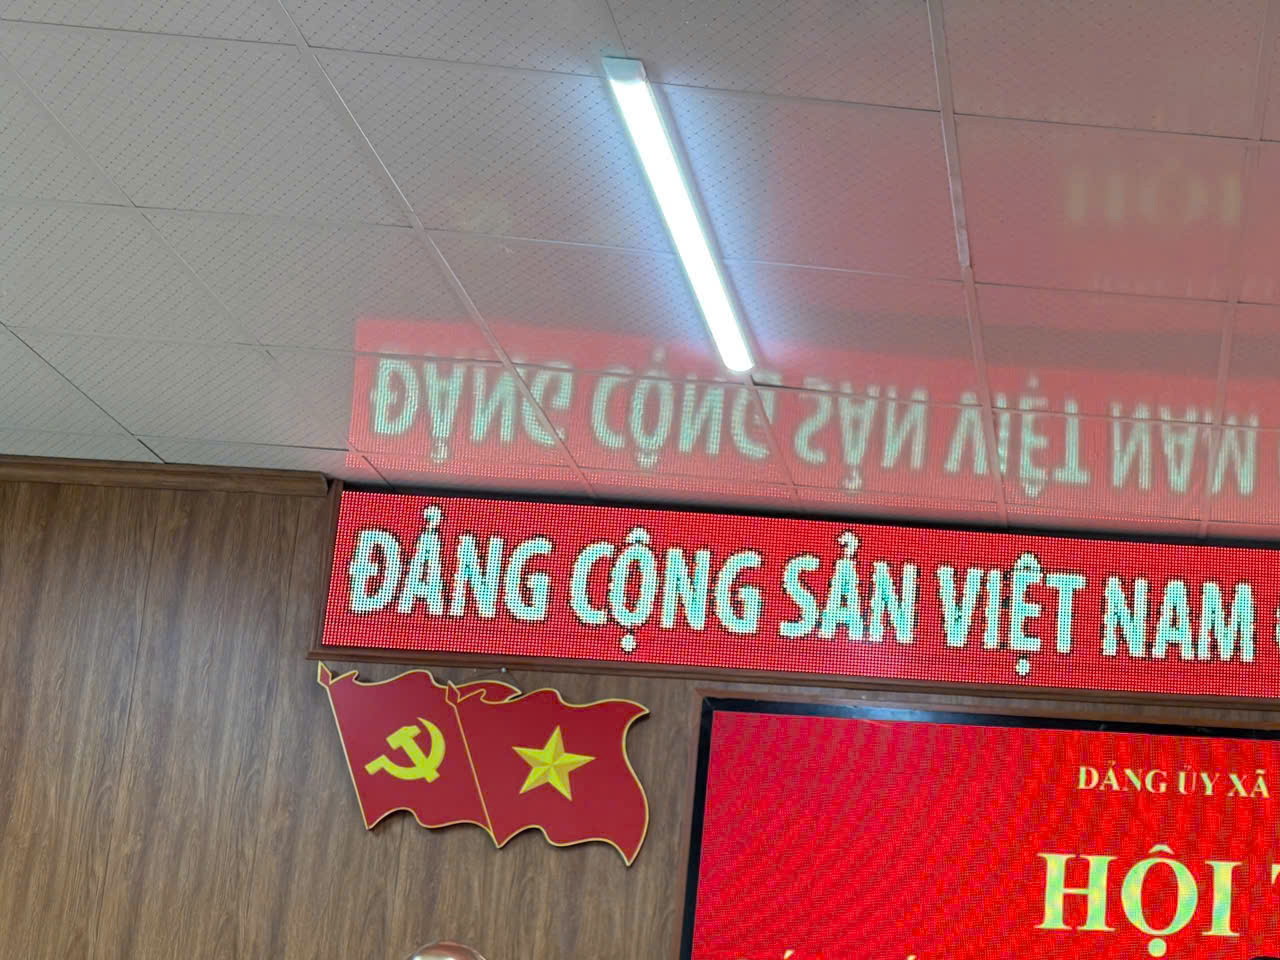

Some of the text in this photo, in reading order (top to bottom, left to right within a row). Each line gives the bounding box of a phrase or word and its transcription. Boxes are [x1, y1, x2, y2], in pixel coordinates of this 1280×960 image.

[348, 506, 553, 622] ĐẢNG
[569, 527, 762, 652] CỘNG
[779, 532, 917, 645] SẢN
[936, 553, 1086, 676] VIỆT
[1102, 576, 1256, 663] NAM
[1227, 768, 1270, 798] XÃ
[1036, 845, 1241, 957] HỘI
